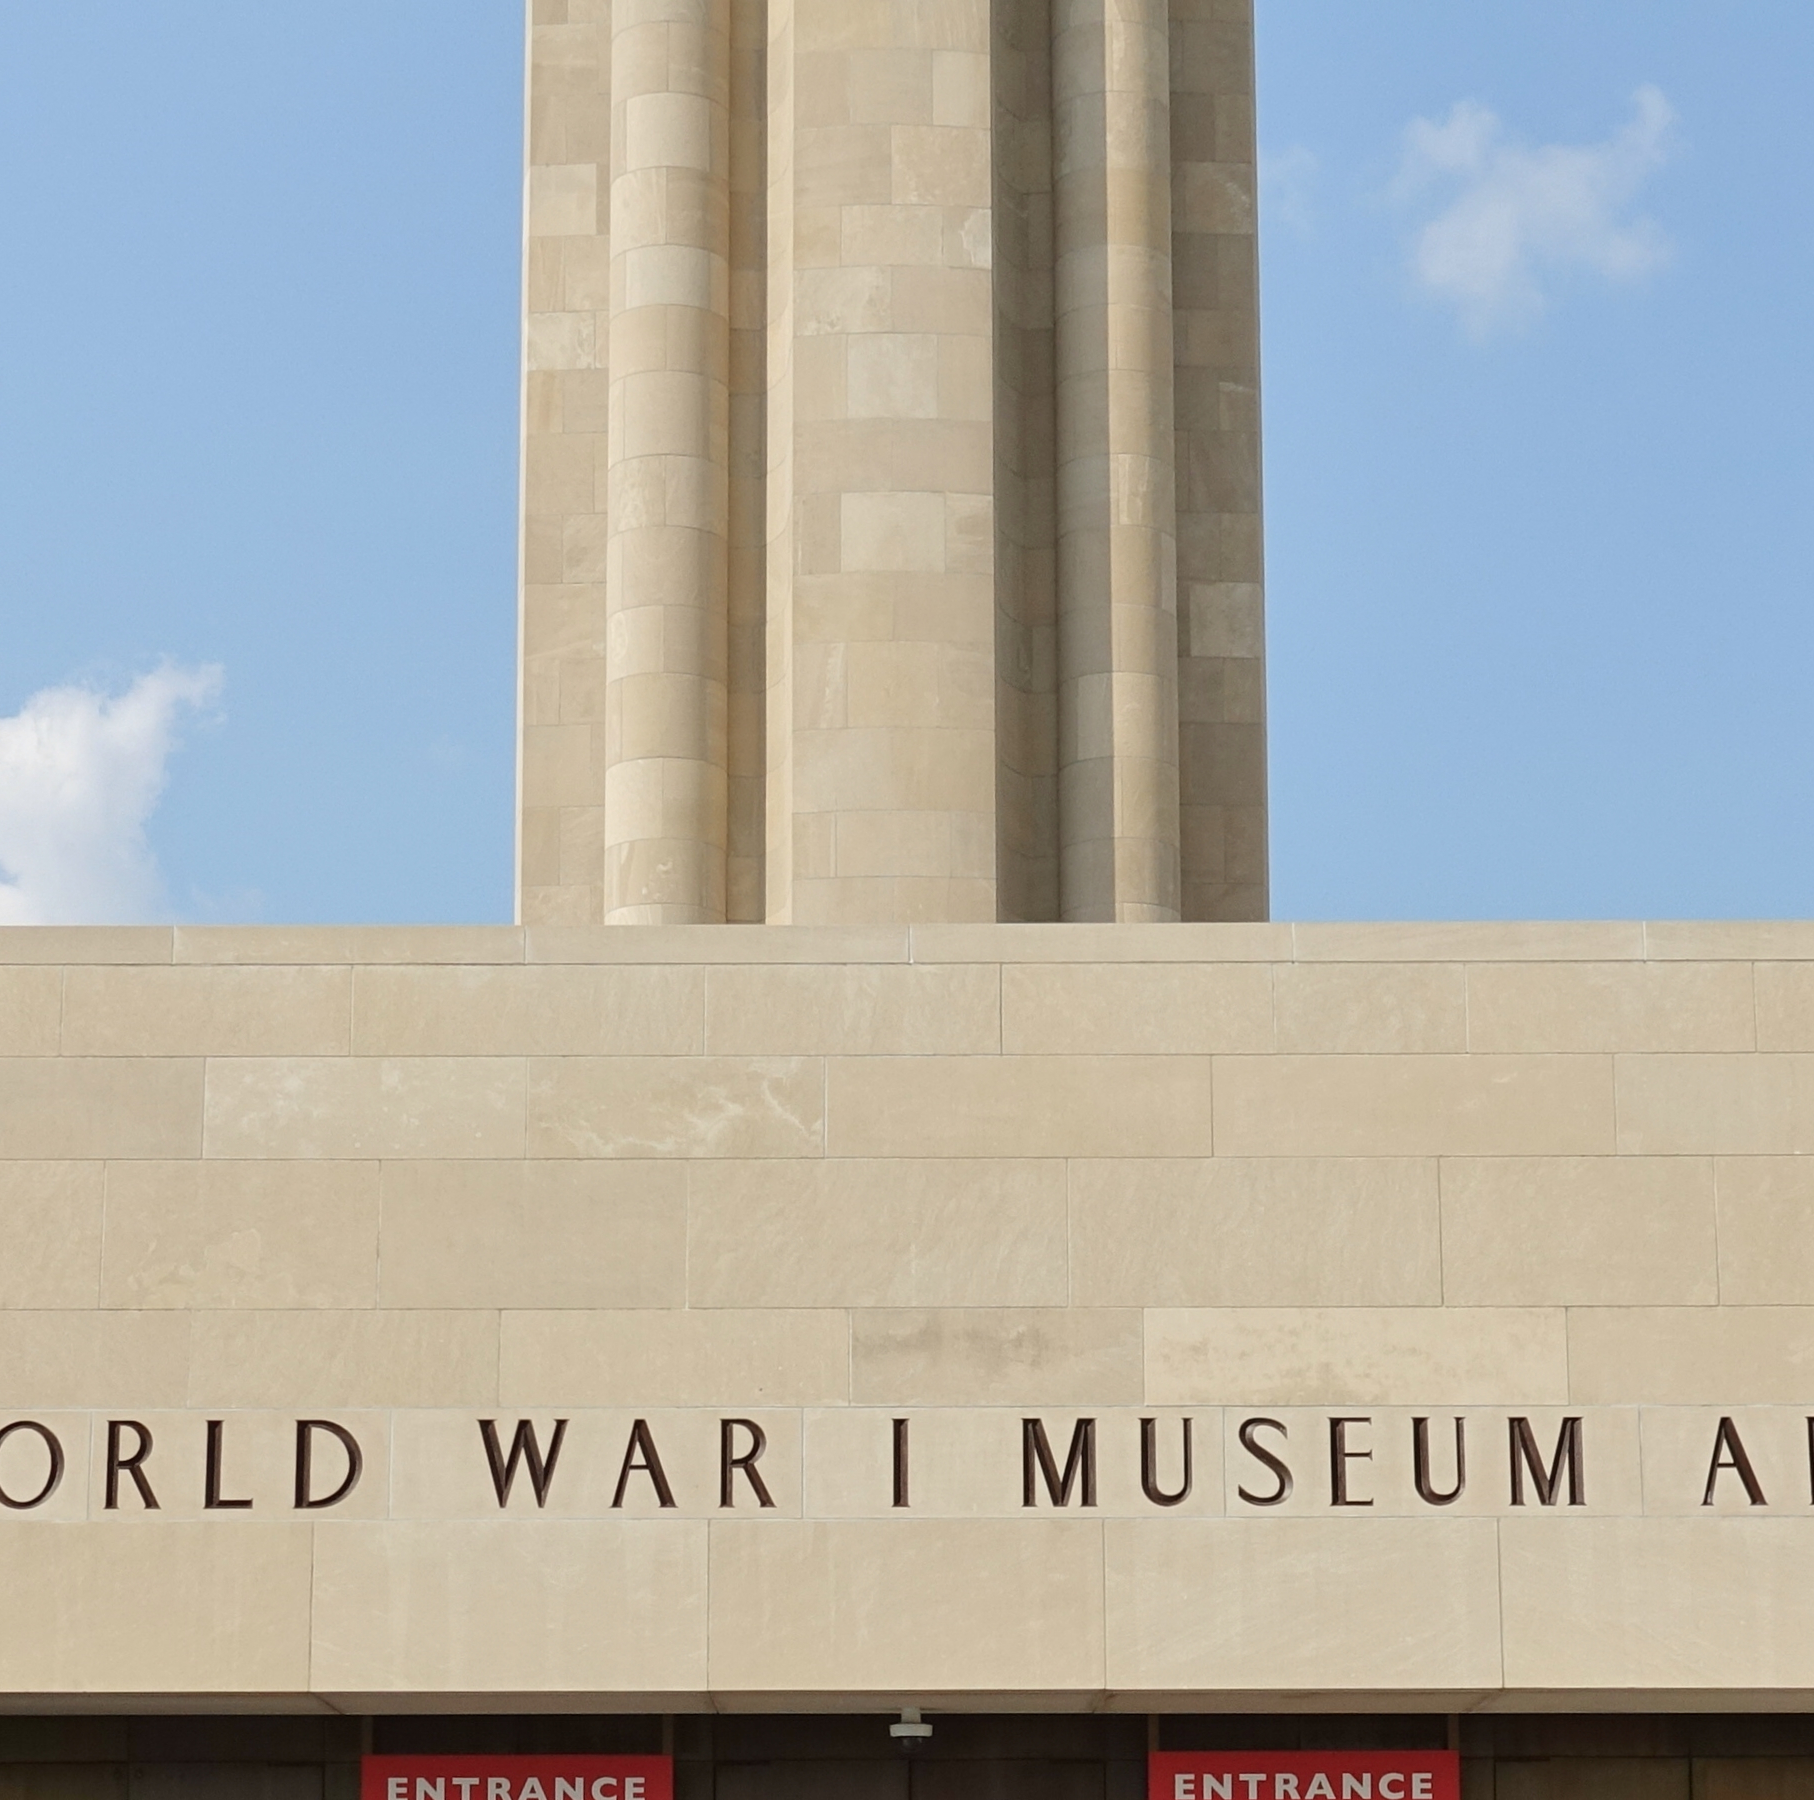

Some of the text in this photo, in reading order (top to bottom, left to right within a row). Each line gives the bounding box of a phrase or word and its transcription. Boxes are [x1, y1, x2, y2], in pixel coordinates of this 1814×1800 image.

[477, 1417, 776, 1510] WAR
[890, 1417, 910, 1508] I
[1021, 1416, 1586, 1509] MUSEUM
[1174, 1772, 1434, 1800] ENTRANCE
